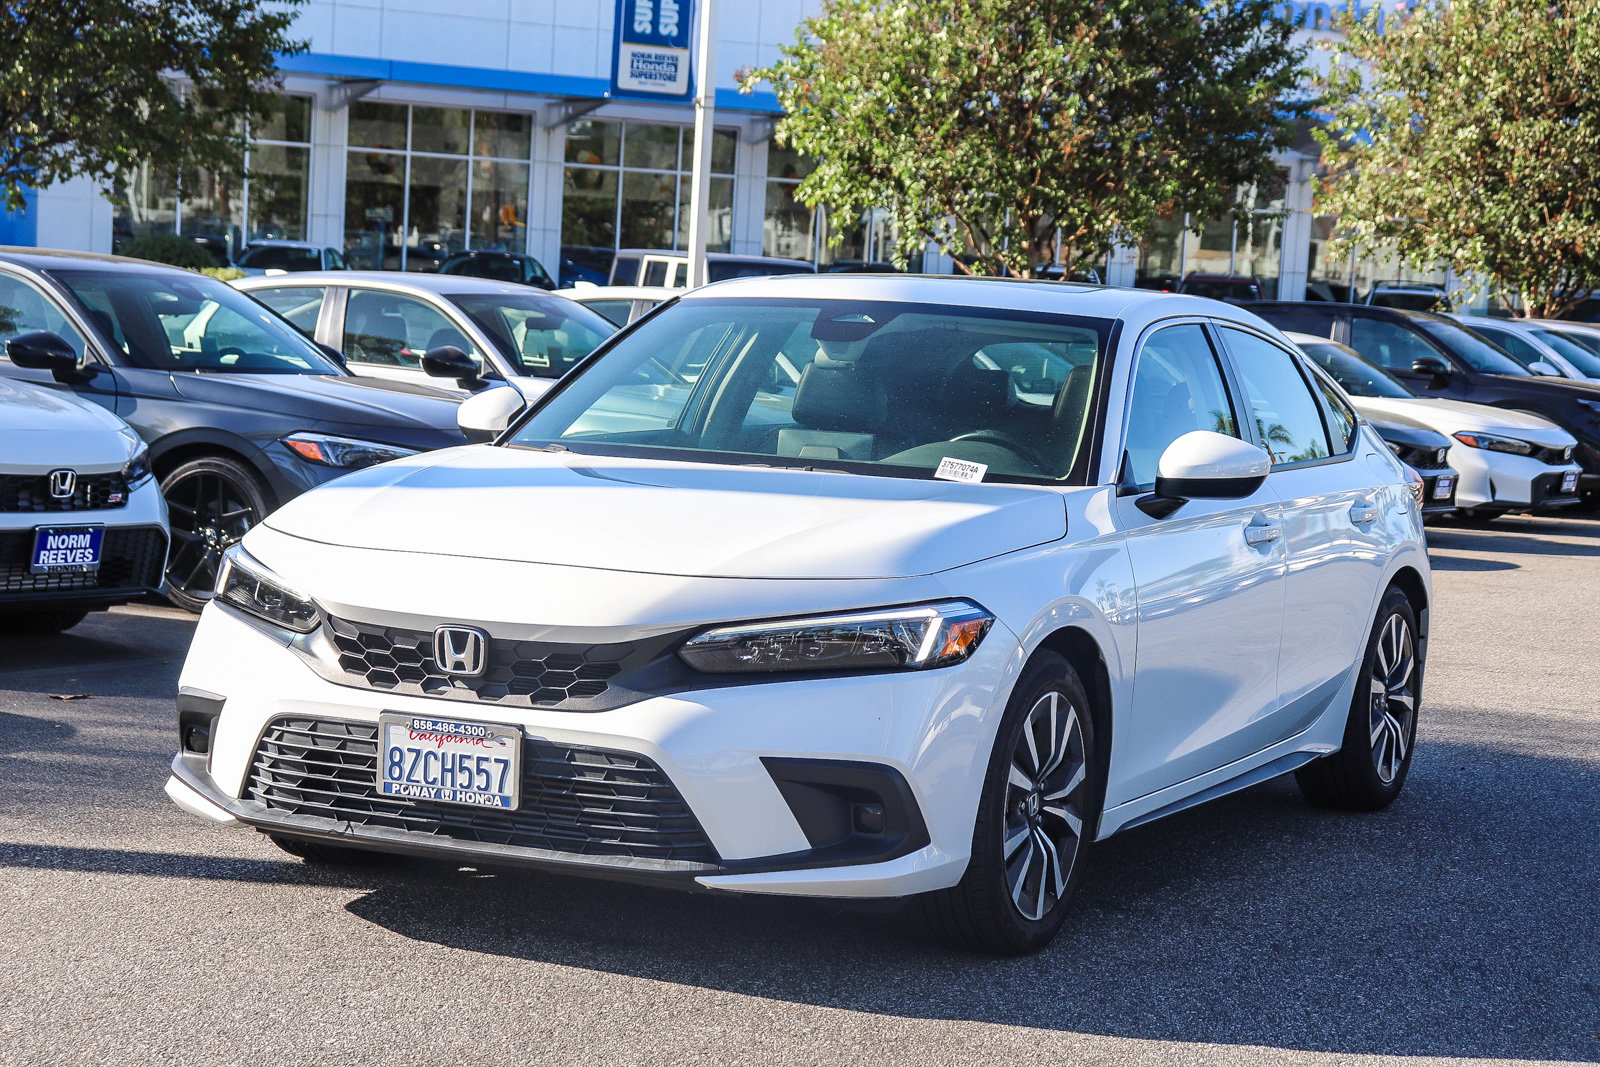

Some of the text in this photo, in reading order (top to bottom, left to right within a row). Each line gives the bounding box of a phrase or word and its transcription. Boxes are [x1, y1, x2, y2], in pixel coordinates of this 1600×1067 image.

[632, 60, 676, 72] Honda
[630, 70, 678, 82] SUPERSTORE
[46, 534, 91, 549] NORM
[39, 548, 94, 564] REEVES
[413, 719, 485, 737] 858-486-4300
[388, 746, 511, 794] 8ZCH557
[392, 783, 503, 807] POWAY HONDA
